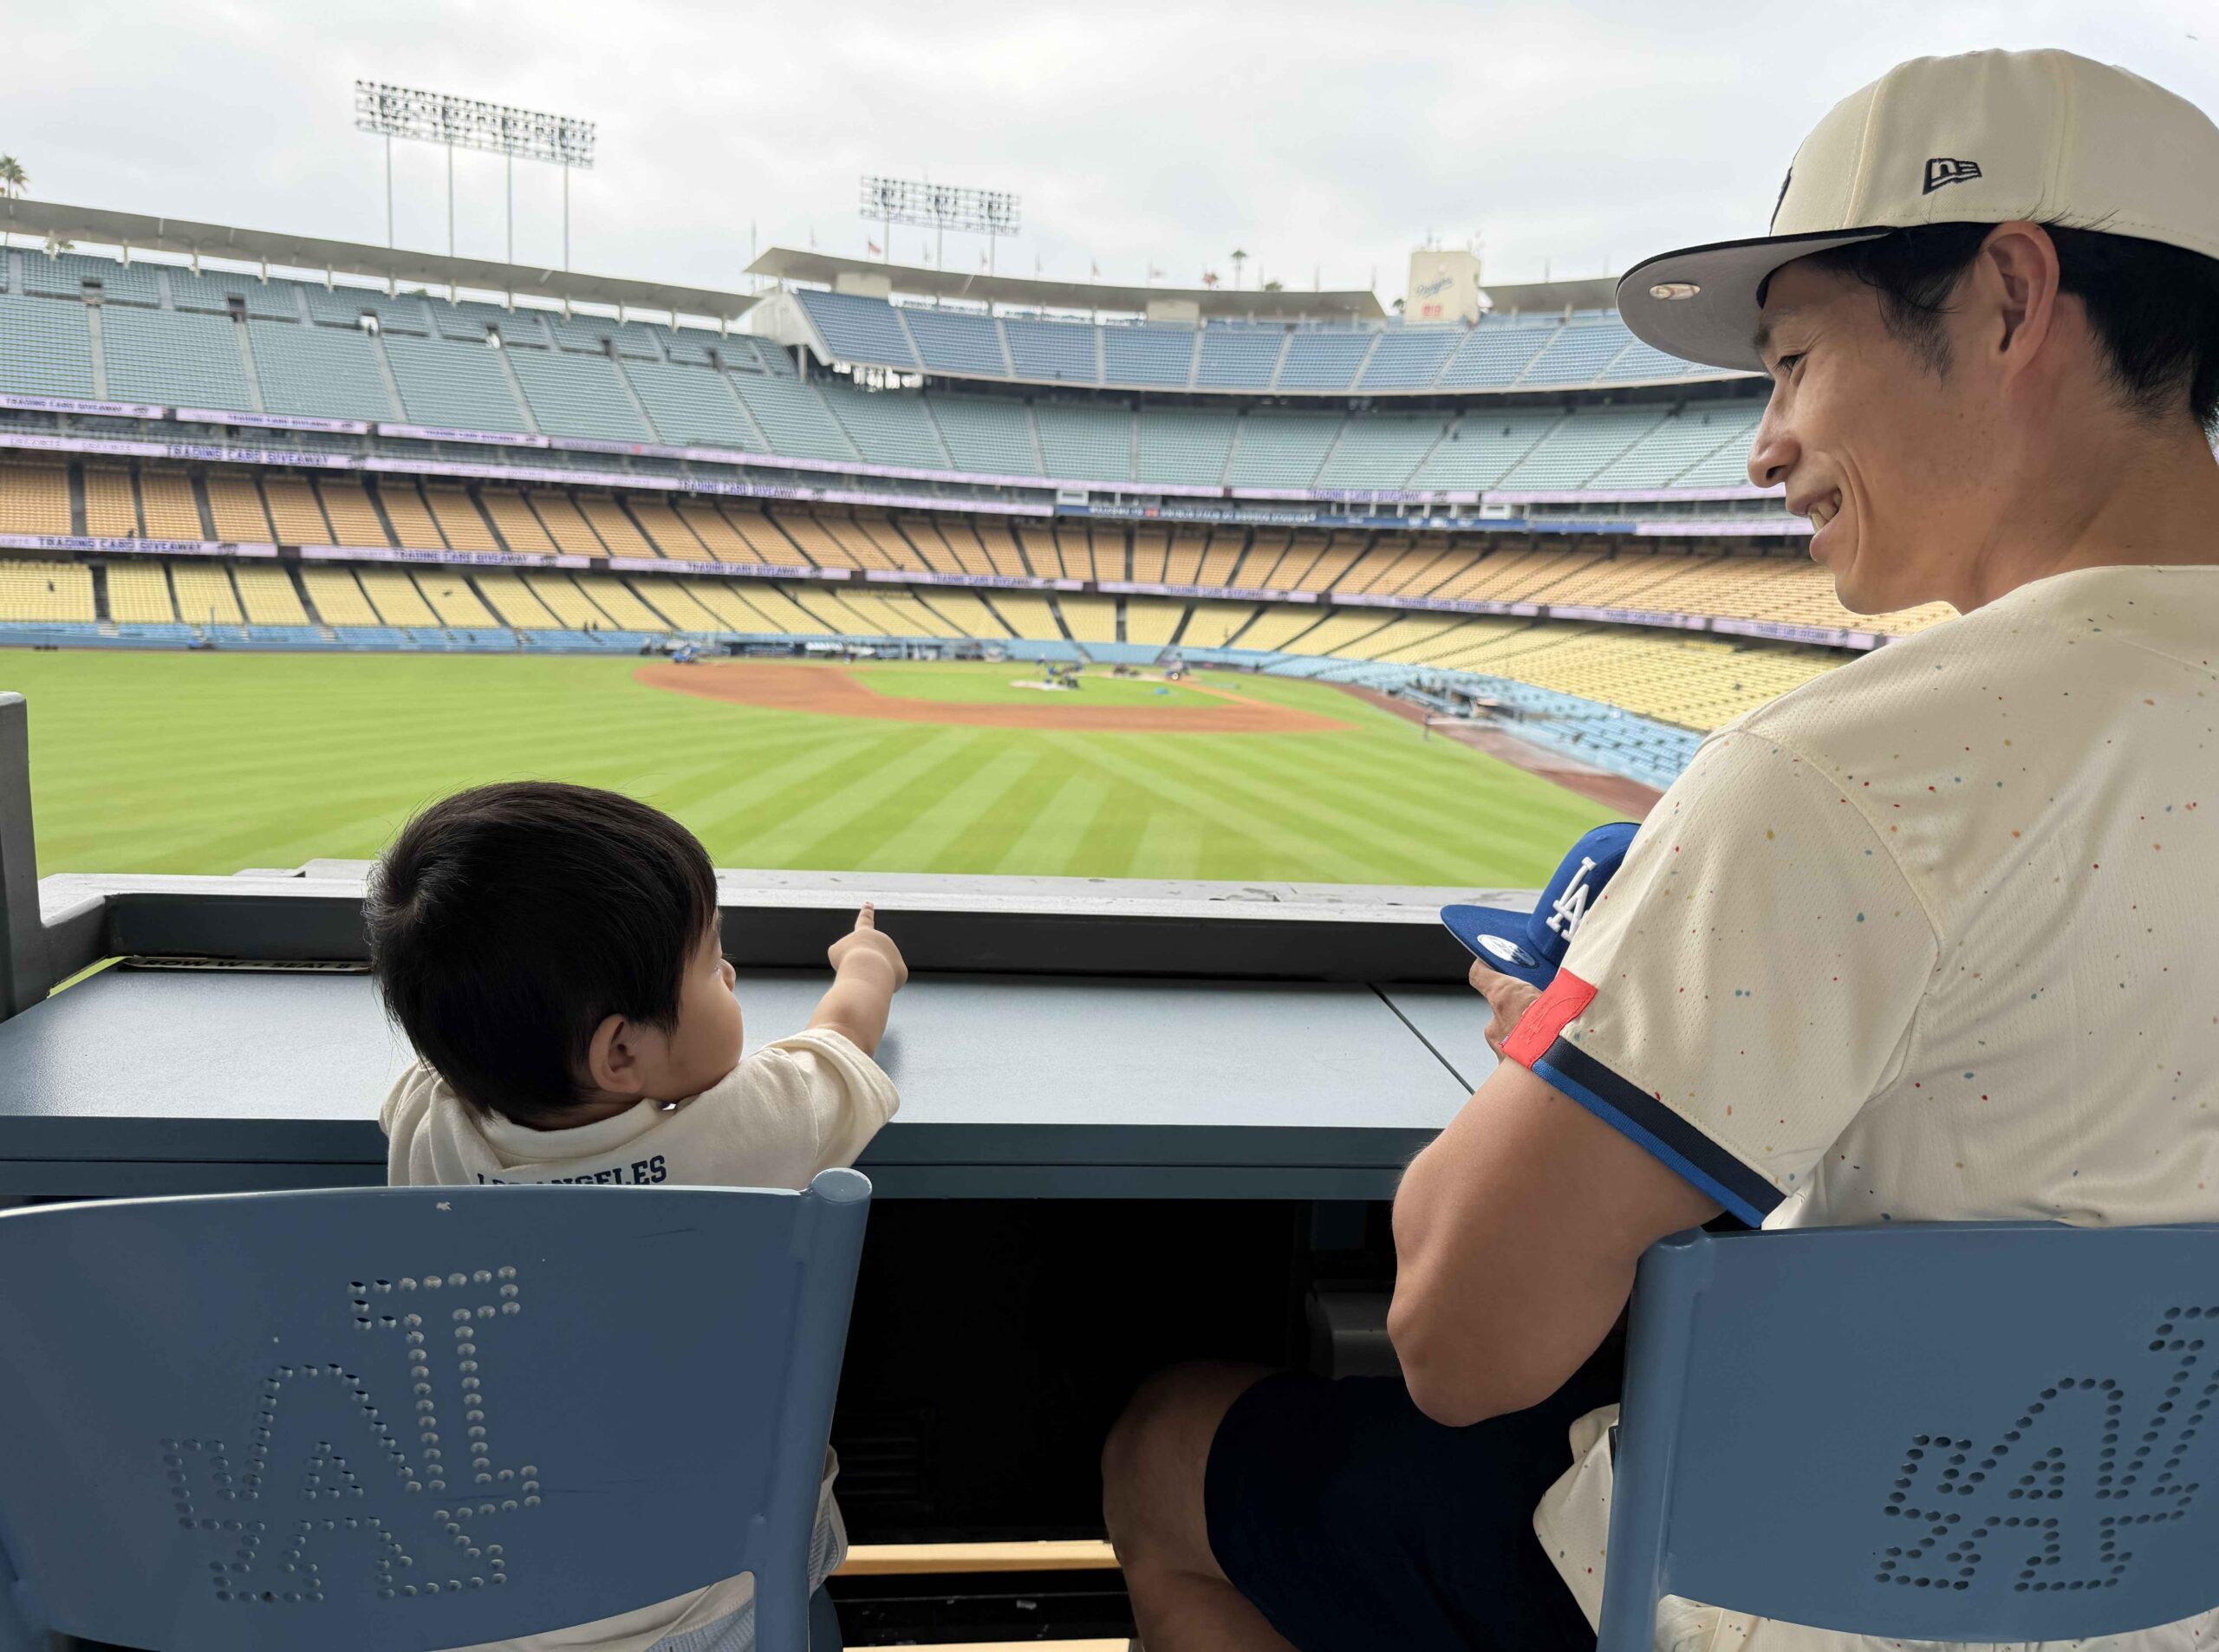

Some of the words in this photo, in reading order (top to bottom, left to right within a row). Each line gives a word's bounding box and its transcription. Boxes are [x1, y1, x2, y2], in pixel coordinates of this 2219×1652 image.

[166, 445, 223, 460] TRADING
[37, 537, 95, 550] TRADING
[100, 540, 135, 551] CARD
[140, 541, 202, 554] GIVEAWAY
[1545, 856, 1597, 943] LA
